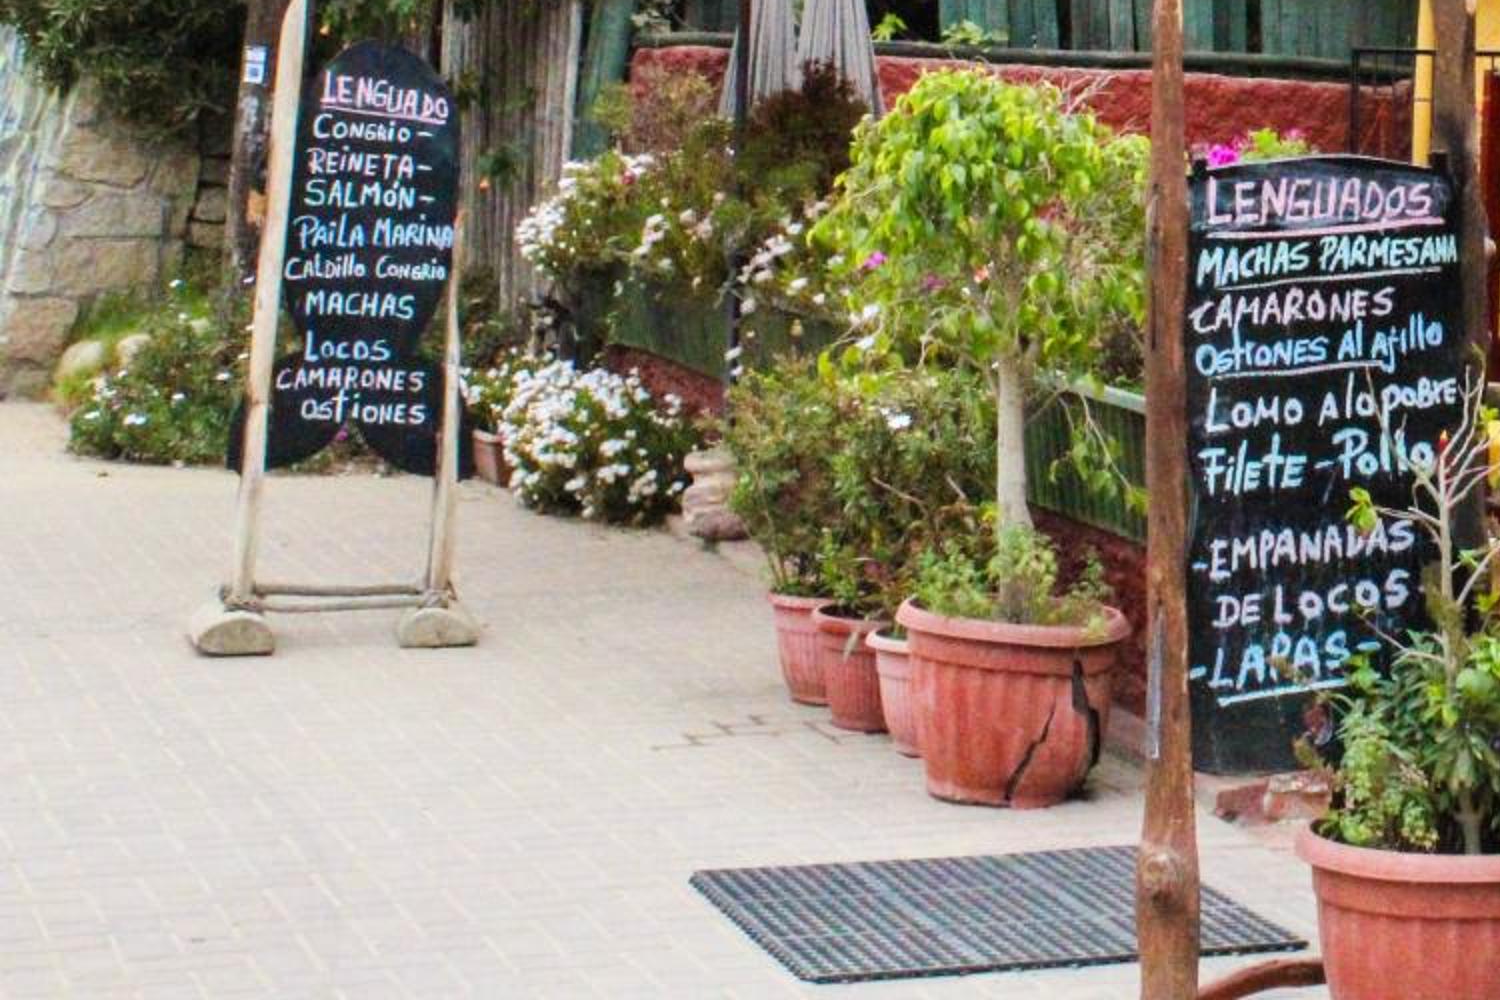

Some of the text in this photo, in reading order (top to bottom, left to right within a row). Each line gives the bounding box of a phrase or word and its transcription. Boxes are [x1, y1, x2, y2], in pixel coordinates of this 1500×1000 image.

[320, 70, 449, 118] LENGUADO
[1206, 175, 1433, 226] LENGUADOS
[1196, 234, 1459, 289] MACHAS PARMESANA
[305, 289, 415, 320] MACHAS
[1188, 286, 1397, 334] CAMARONES
[275, 365, 426, 393] CAMARONES
[1212, 592, 1264, 628] DE
